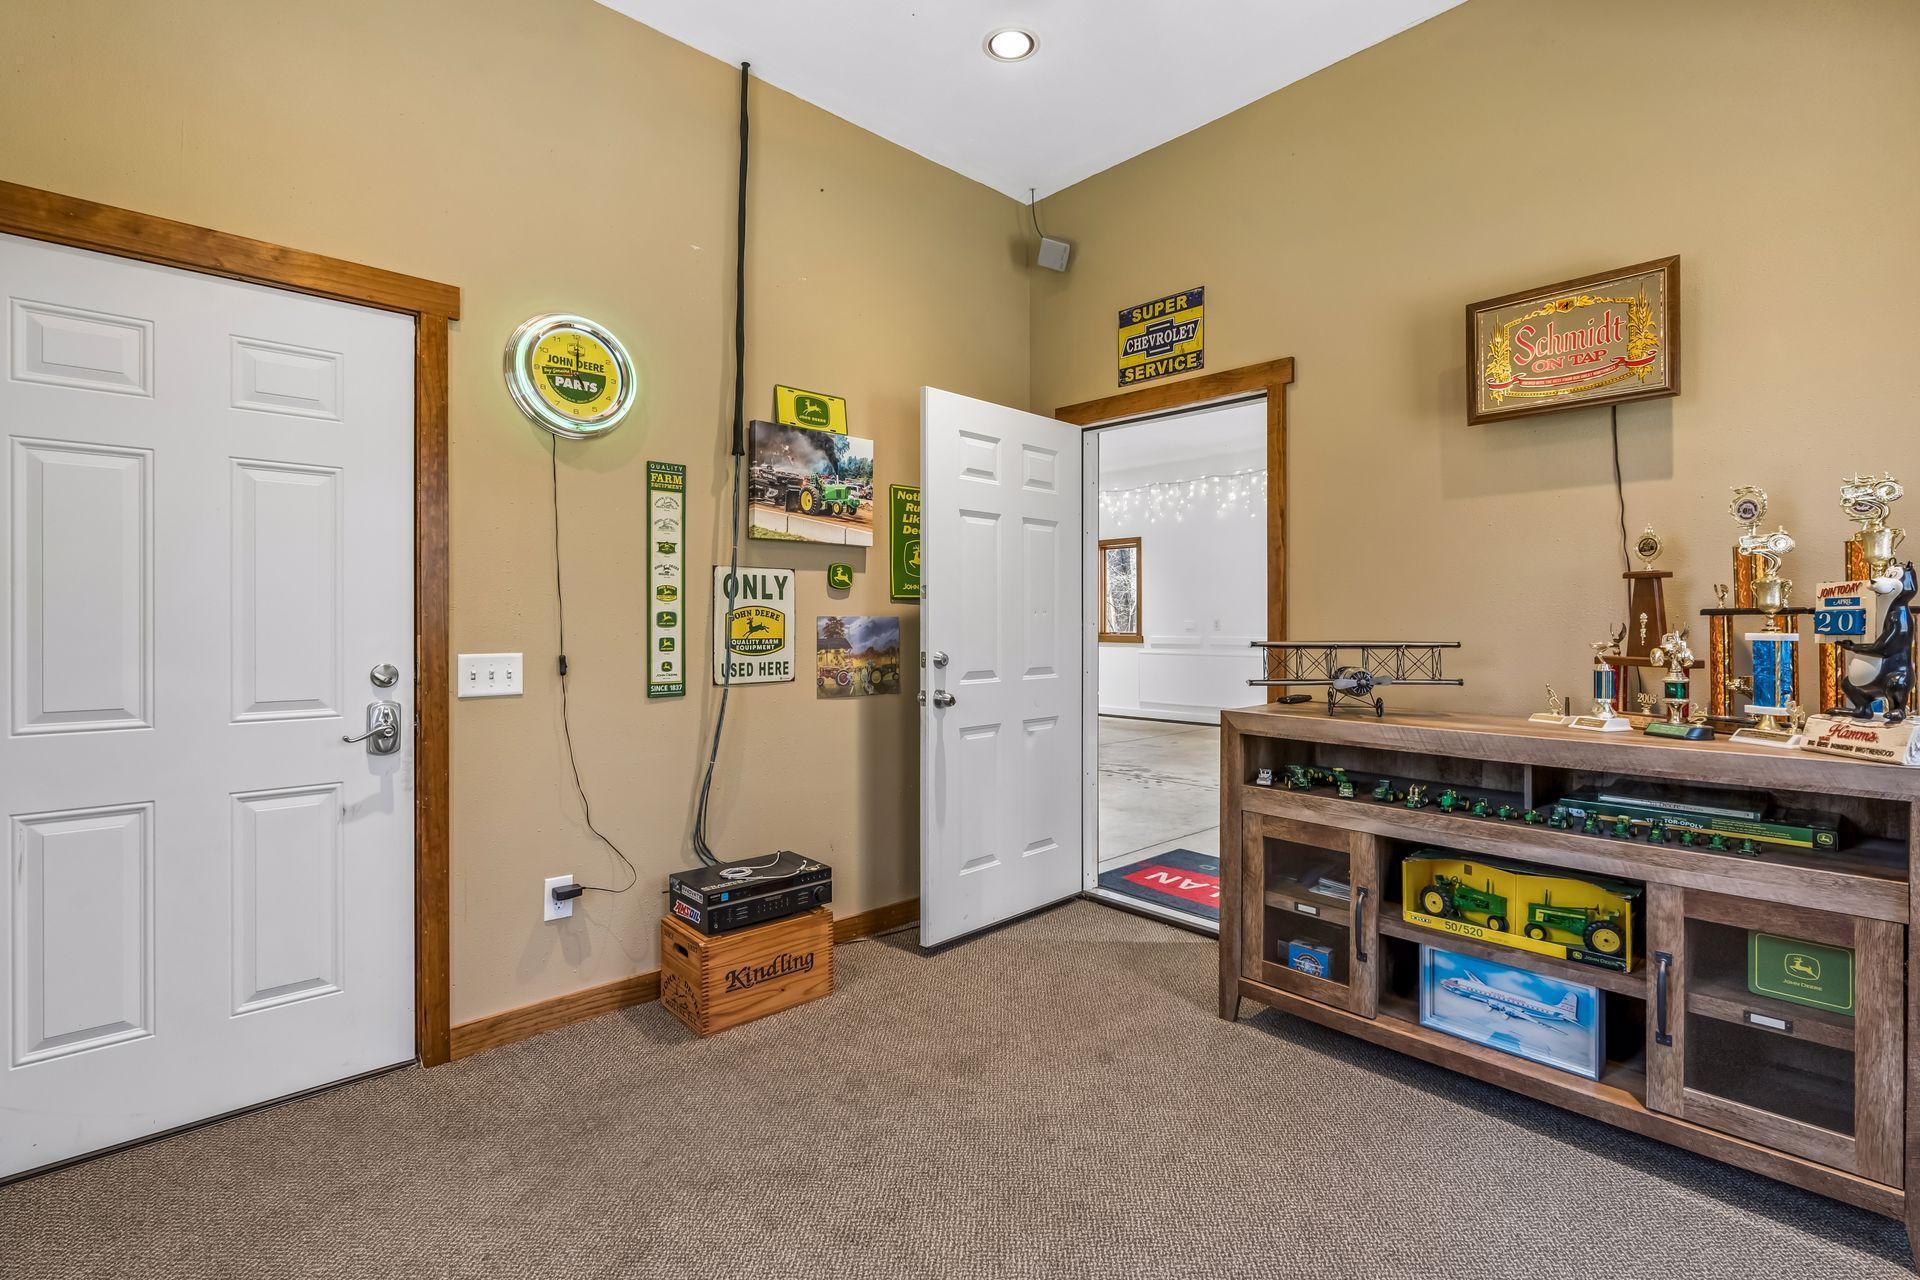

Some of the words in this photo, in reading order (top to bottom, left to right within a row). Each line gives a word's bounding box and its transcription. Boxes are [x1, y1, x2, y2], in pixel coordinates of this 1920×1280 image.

[1132, 295, 1188, 323] SUPER
[1126, 323, 1195, 353] CHEVROLET
[1513, 309, 1626, 366] Schmidt
[547, 354, 574, 367] JOHN
[577, 360, 605, 373] DEERE
[1125, 353, 1197, 382] SERVICE
[1531, 356, 1565, 373] ON
[1568, 349, 1608, 366] TAP
[555, 376, 598, 393] PARTS
[650, 463, 683, 472] QUALITY
[650, 472, 683, 485] FARM
[650, 482, 683, 490] EQUIPMENT
[723, 573, 788, 600] ONLY
[1817, 587, 1836, 599] JOIN
[1837, 581, 1862, 595] TODAY
[755, 609, 781, 621] DEERE
[1817, 612, 1854, 632] 20
[721, 662, 753, 678] USED
[759, 661, 789, 676] HERE
[669, 684, 683, 692] 1837
[1637, 693, 1657, 704] 2005
[1827, 723, 1878, 743] Hamm's
[674, 901, 700, 922] AMSOIL
[1445, 921, 1484, 938] 50/520
[724, 952, 815, 990] Kindling
[1783, 979, 1801, 987] JOHN
[1801, 982, 1823, 992] DEERE
